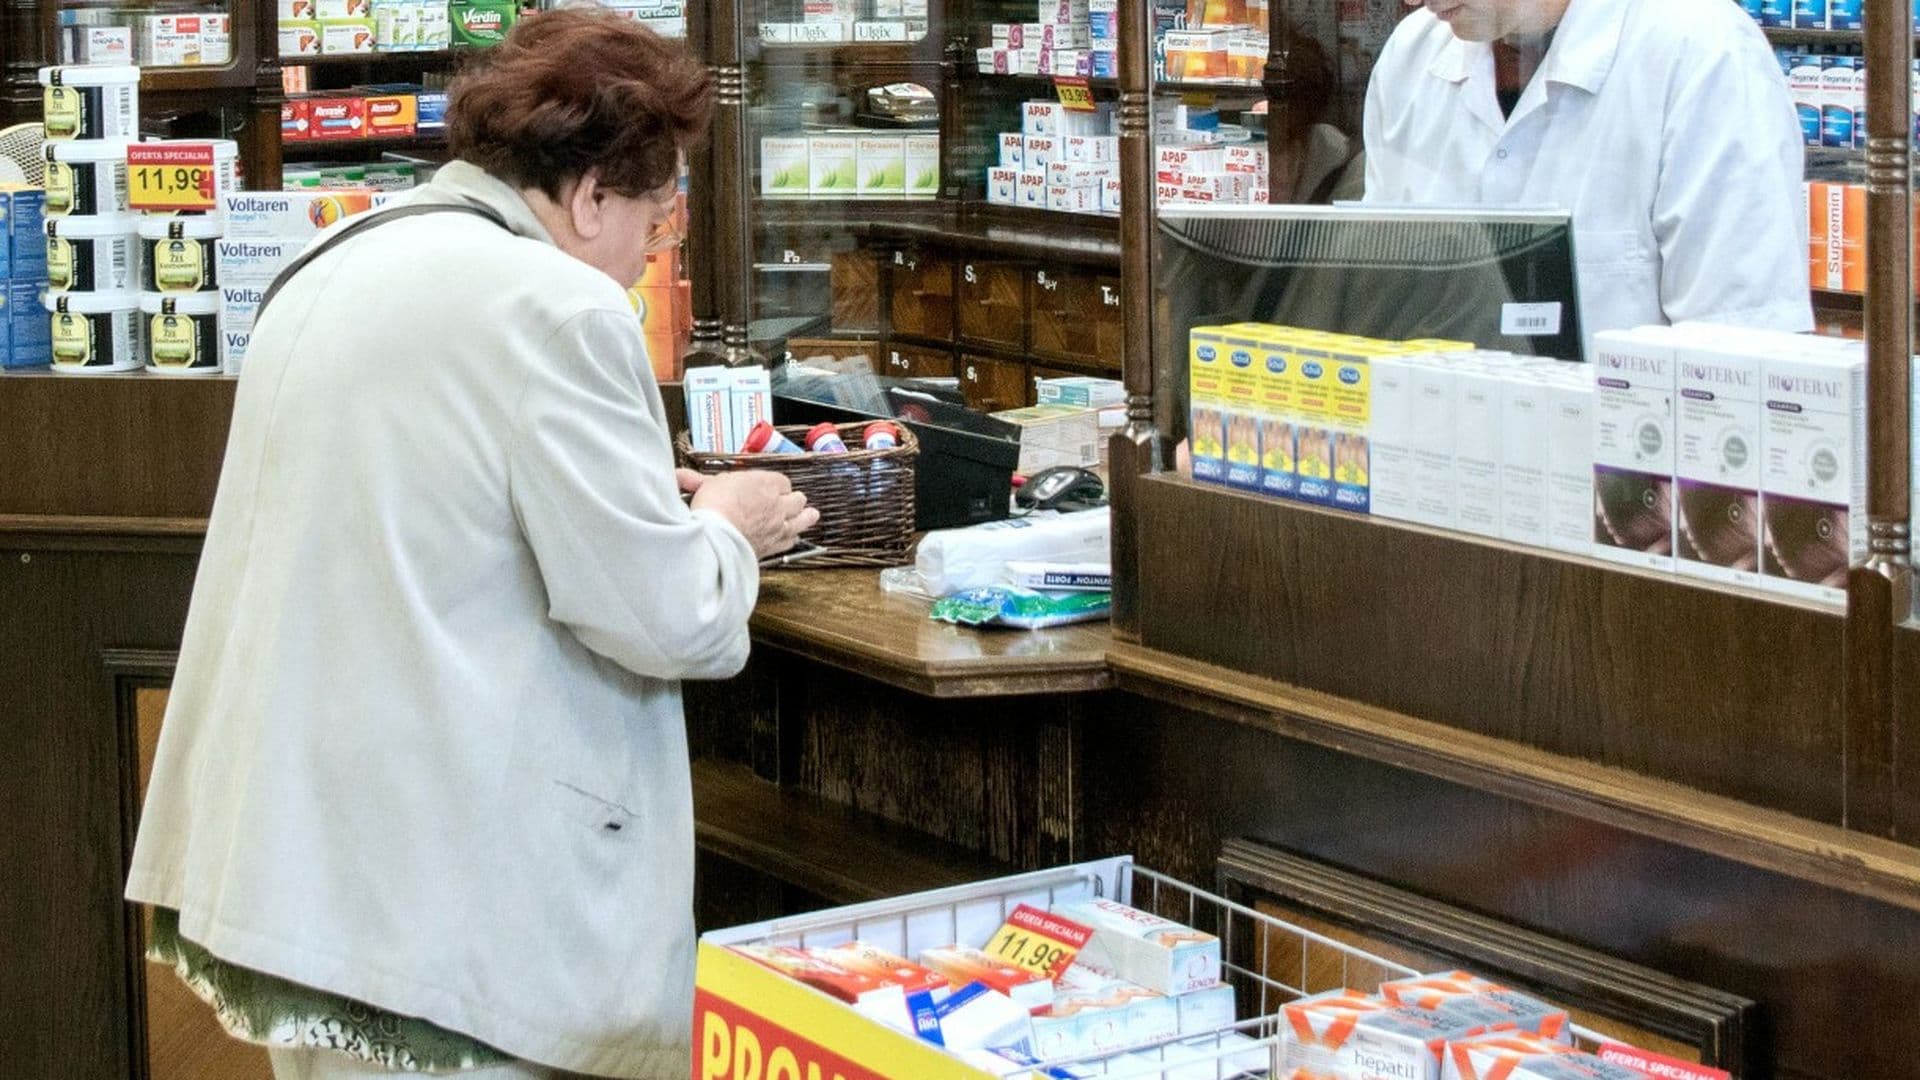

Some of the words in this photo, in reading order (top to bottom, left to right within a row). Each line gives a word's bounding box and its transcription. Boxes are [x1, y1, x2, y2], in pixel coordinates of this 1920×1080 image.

[463, 8, 501, 23] Verdin
[859, 25, 892, 40] Ulgix
[315, 105, 347, 117] Rennie
[371, 103, 398, 113] Rennie
[1028, 105, 1052, 116] APAP
[1029, 140, 1052, 151] APAP
[131, 151, 162, 160] OFERTA
[163, 151, 210, 160] SPECJALNA
[1161, 150, 1188, 163] APAP
[1231, 149, 1249, 158] APAP
[137, 167, 202, 194] 11,99
[1020, 174, 1043, 186] APAP
[1187, 175, 1207, 185] APAP
[227, 198, 289, 211] Voltaren
[1829, 192, 1841, 273] Supremin
[219, 243, 281, 257] Voltaren
[1013, 910, 1043, 926] OFERTA
[1043, 919, 1085, 942] SPECJALNA
[1354, 1050, 1416, 1079] hepatil
[1602, 1049, 1647, 1070] OFERTA
